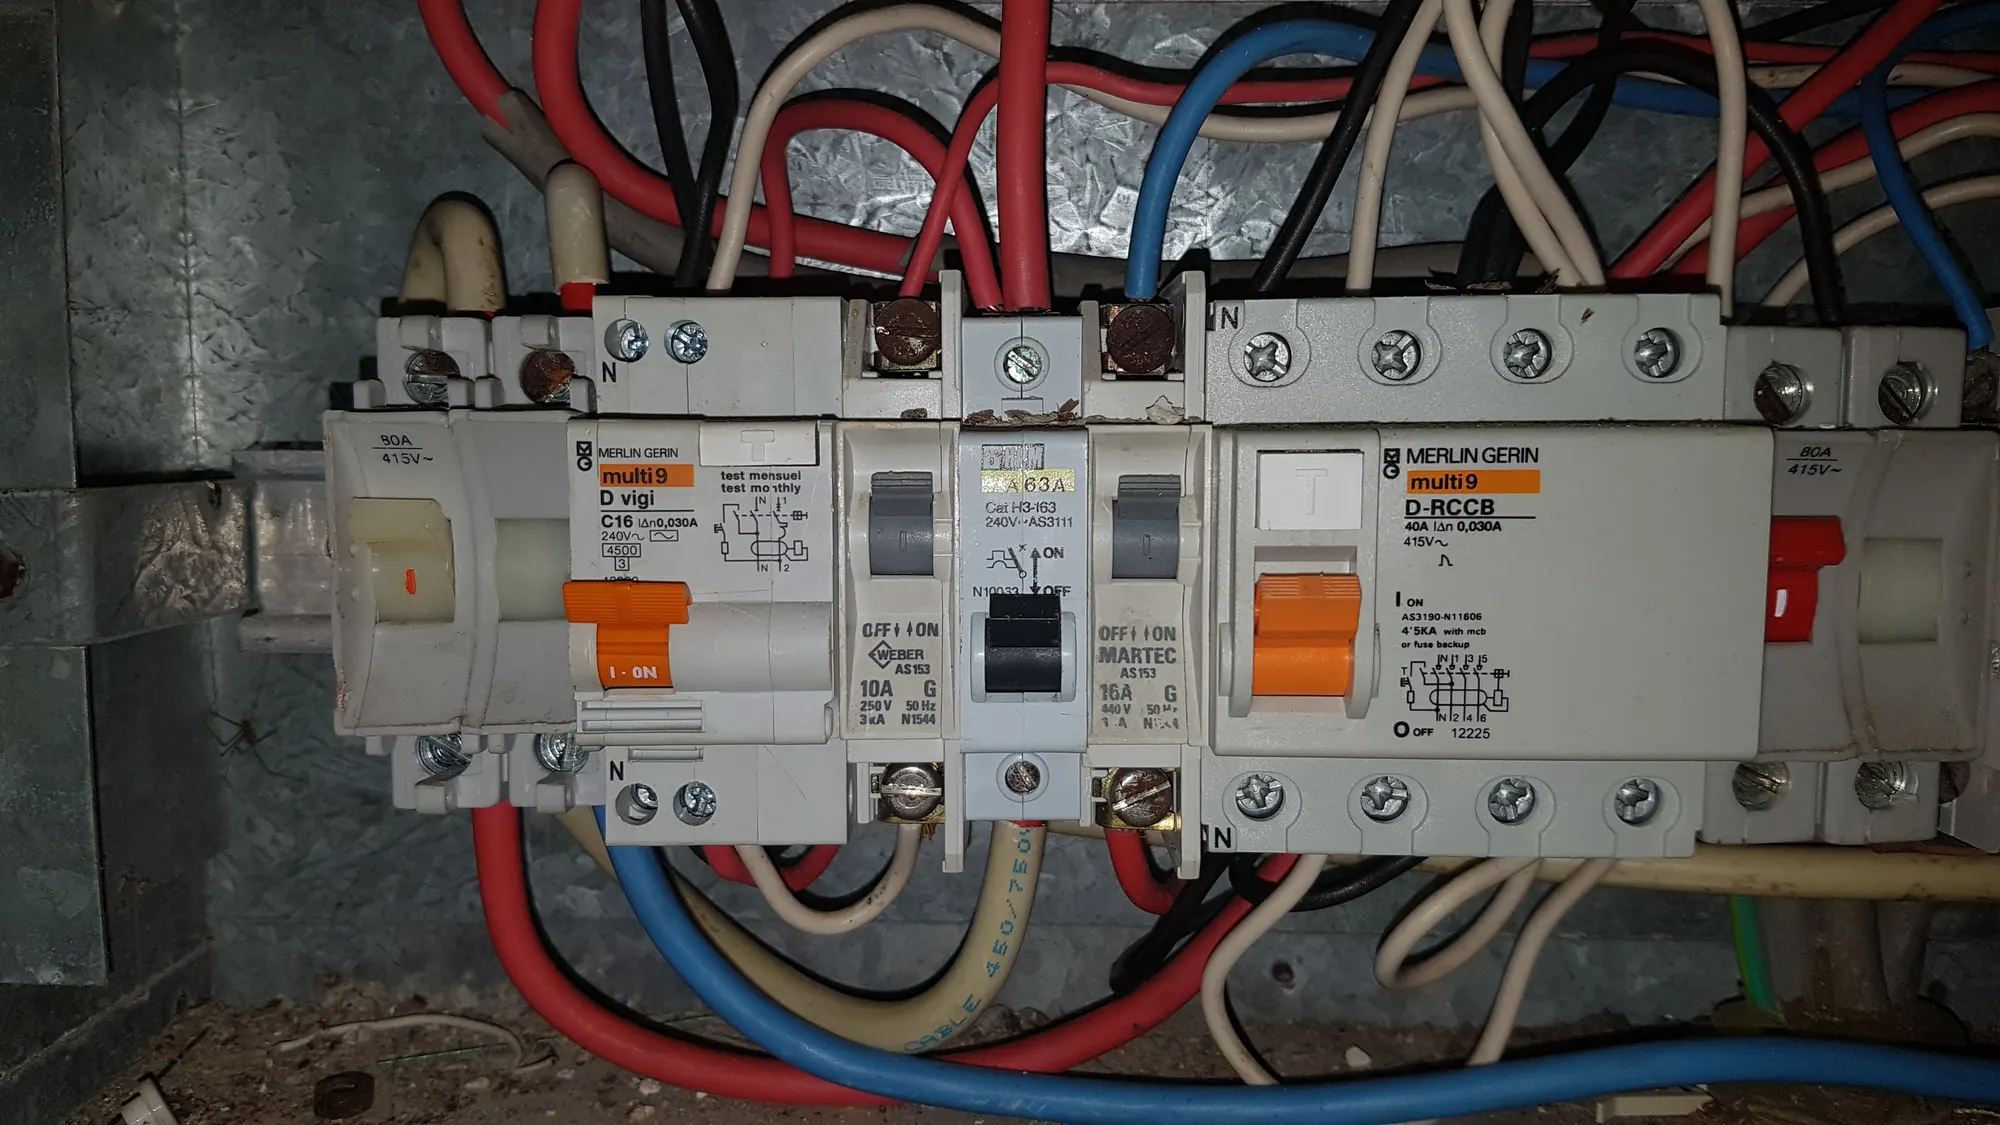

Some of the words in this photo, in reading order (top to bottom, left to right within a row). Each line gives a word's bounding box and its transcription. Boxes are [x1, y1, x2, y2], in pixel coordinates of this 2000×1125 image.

[1221, 306, 1239, 330] N
[602, 361, 617, 383] N
[380, 434, 413, 446] 80A
[598, 447, 641, 459] MERLIN
[644, 447, 679, 459] GERIN
[1406, 448, 1478, 464] MERLIN
[1481, 447, 1539, 464] GERIN
[1800, 447, 1831, 457] 80A
[720, 470, 745, 481] test
[749, 470, 802, 481] mensuel
[721, 483, 746, 493] test
[750, 483, 801, 495] monthly
[600, 489, 615, 506] D
[621, 489, 655, 509] vigi
[759, 496, 767, 505] N
[1405, 498, 1495, 516] D-RCCB
[601, 514, 634, 528] C16
[1404, 521, 1429, 532] 40A
[1456, 520, 1502, 533] 0,030A
[606, 545, 638, 556] 4500
[1043, 547, 1064, 559] ON
[617, 558, 626, 569] 3
[761, 564, 769, 573] N
[783, 564, 790, 573] 2
[1043, 585, 1071, 597] OFF
[1406, 598, 1424, 607] ON
[1401, 613, 1482, 621] AS3190-N11606
[862, 622, 892, 638] OFF
[915, 622, 939, 638] ON
[1098, 625, 1128, 641] OFF
[1152, 625, 1176, 641] ON
[1443, 627, 1464, 636] with
[1466, 628, 1487, 636] mcb
[1401, 641, 1411, 649] or
[1414, 640, 1434, 649] fuse
[1436, 640, 1470, 650] backup
[877, 649, 924, 661] WEBER
[1098, 646, 1177, 664] MARTEC
[632, 665, 658, 679] ON
[860, 679, 894, 698] 10A
[924, 679, 937, 698] G
[1099, 683, 1132, 701] 16A
[1164, 684, 1177, 703] G
[1413, 727, 1434, 737] OFF
[1451, 728, 1491, 739] 12225
[610, 760, 624, 781] N
[1215, 826, 1231, 848] N
